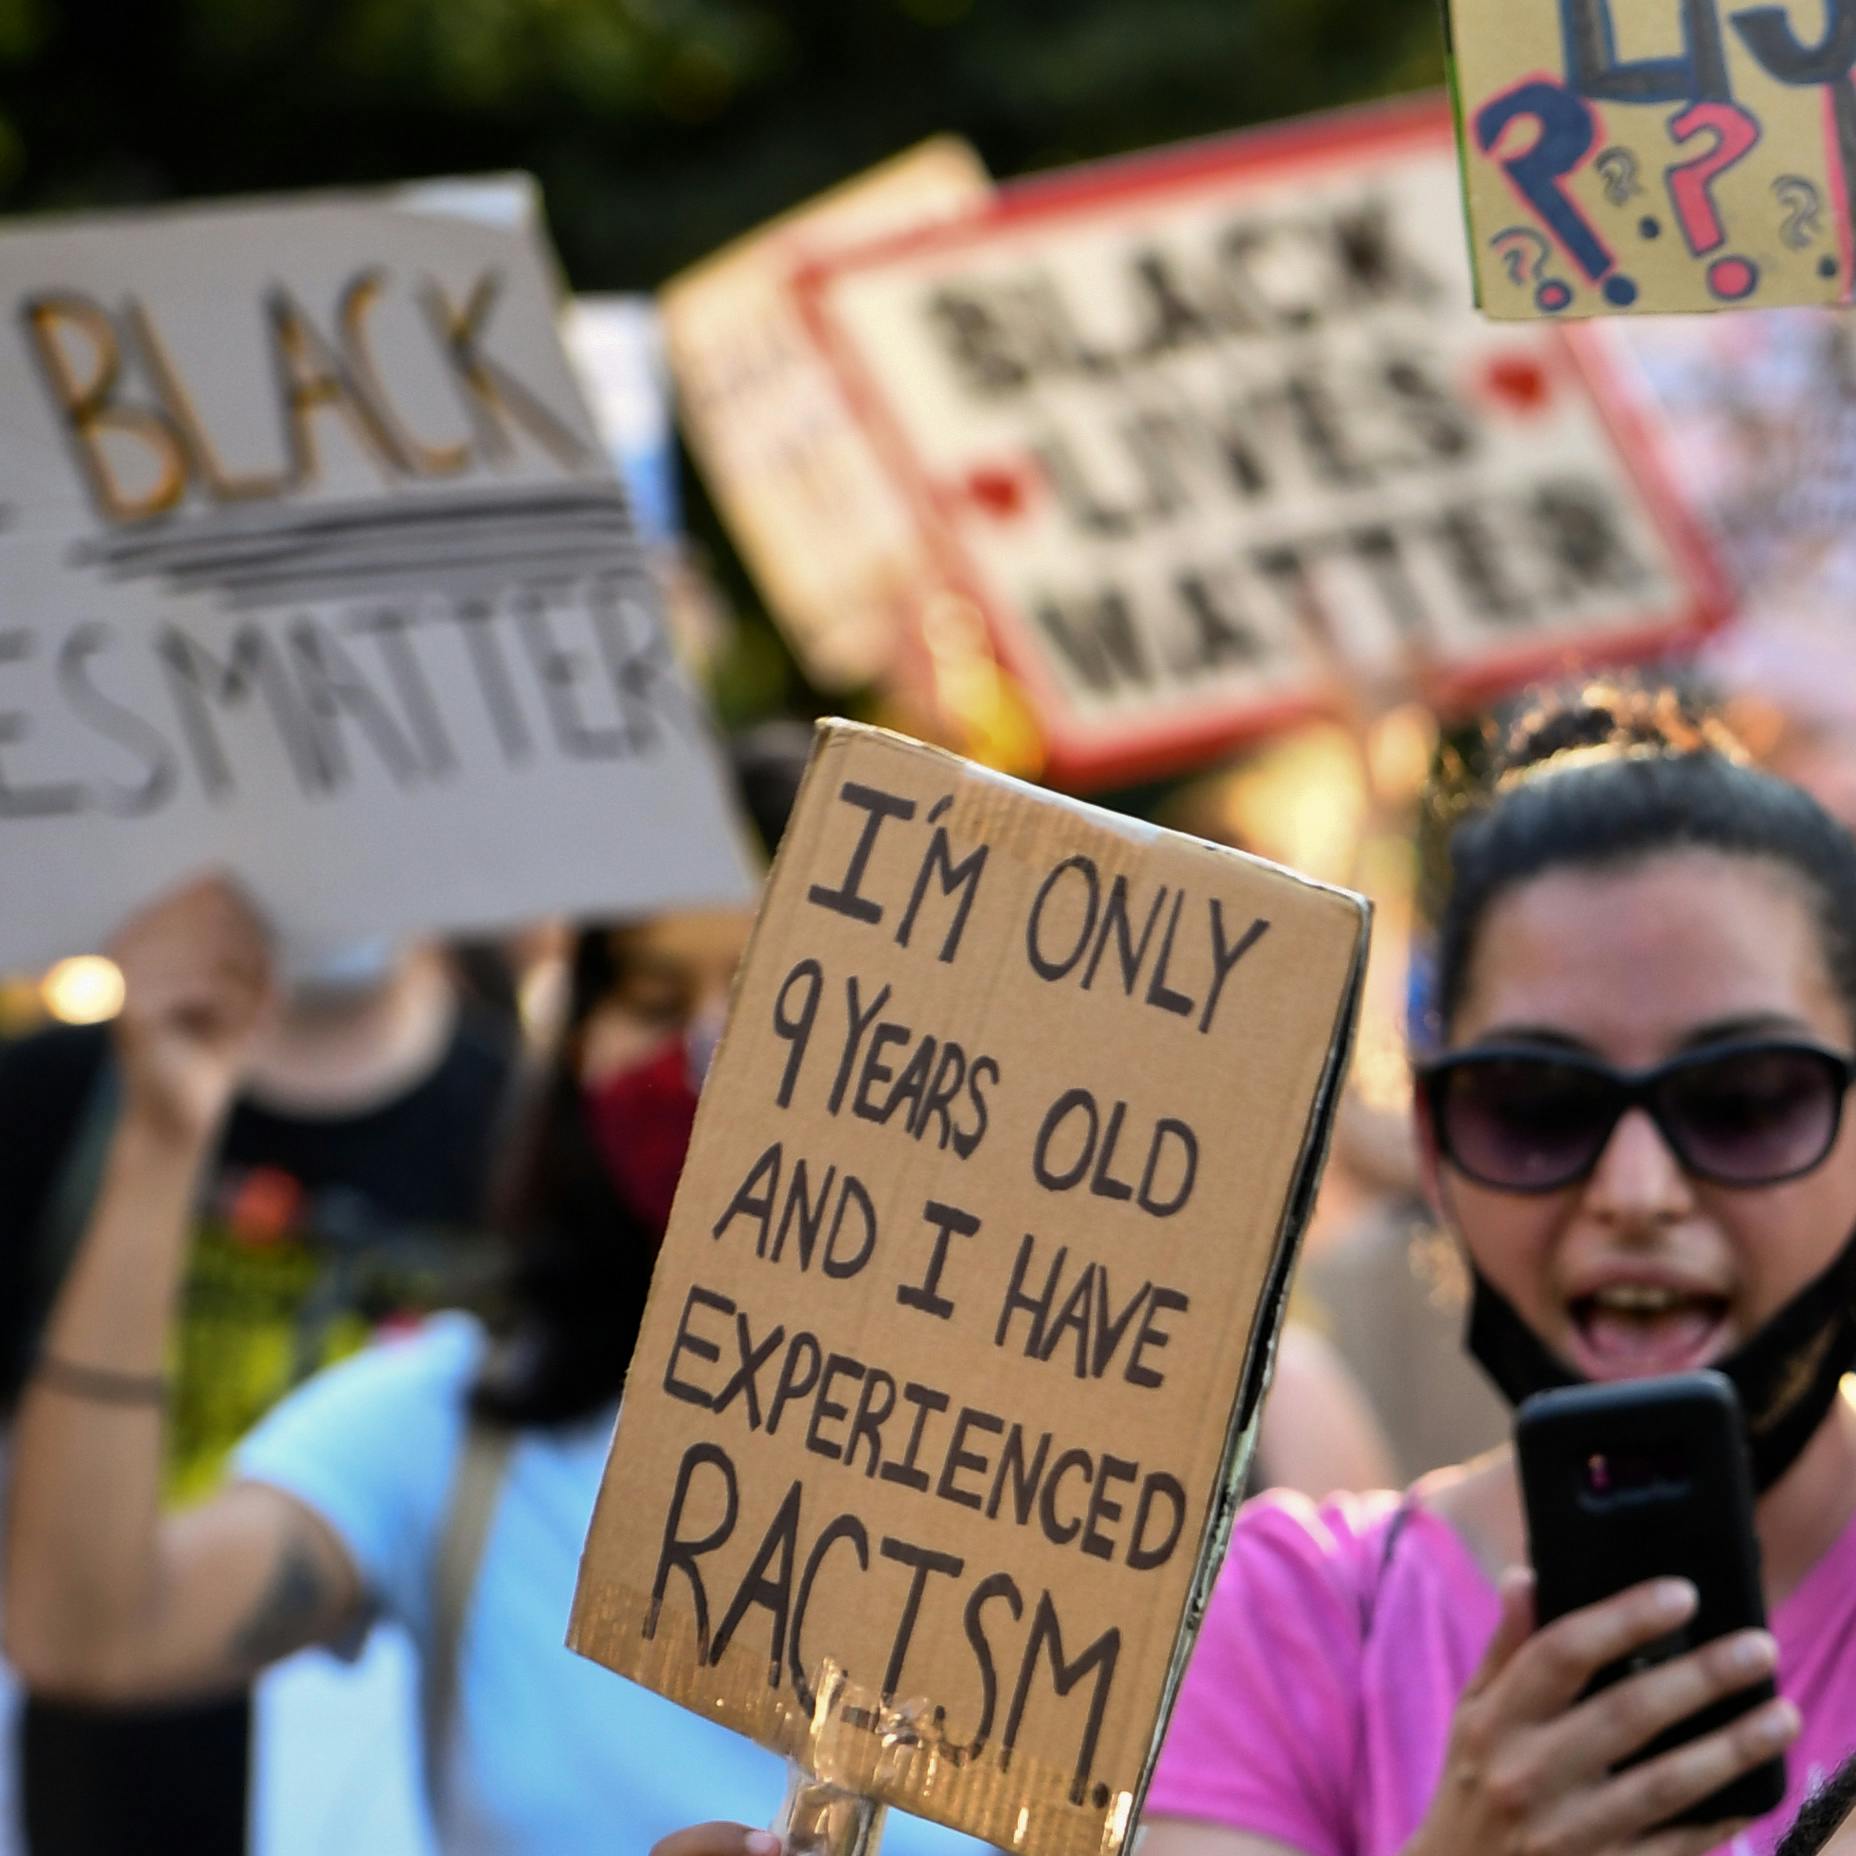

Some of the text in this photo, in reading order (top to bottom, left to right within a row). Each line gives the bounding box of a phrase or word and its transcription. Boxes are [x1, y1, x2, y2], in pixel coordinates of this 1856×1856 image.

[22, 263, 596, 526] BLACK
[927, 200, 1440, 408] BLACK
[1028, 345, 1478, 540] LIVES
[1030, 465, 1650, 700] MATTER
[808, 780, 1271, 1036] I'M ONLY
[772, 958, 1200, 1218] 9 YEARS OLD
[712, 1140, 1189, 1390] AND I HAVE
[661, 1284, 1188, 1573] EXPERIENCED
